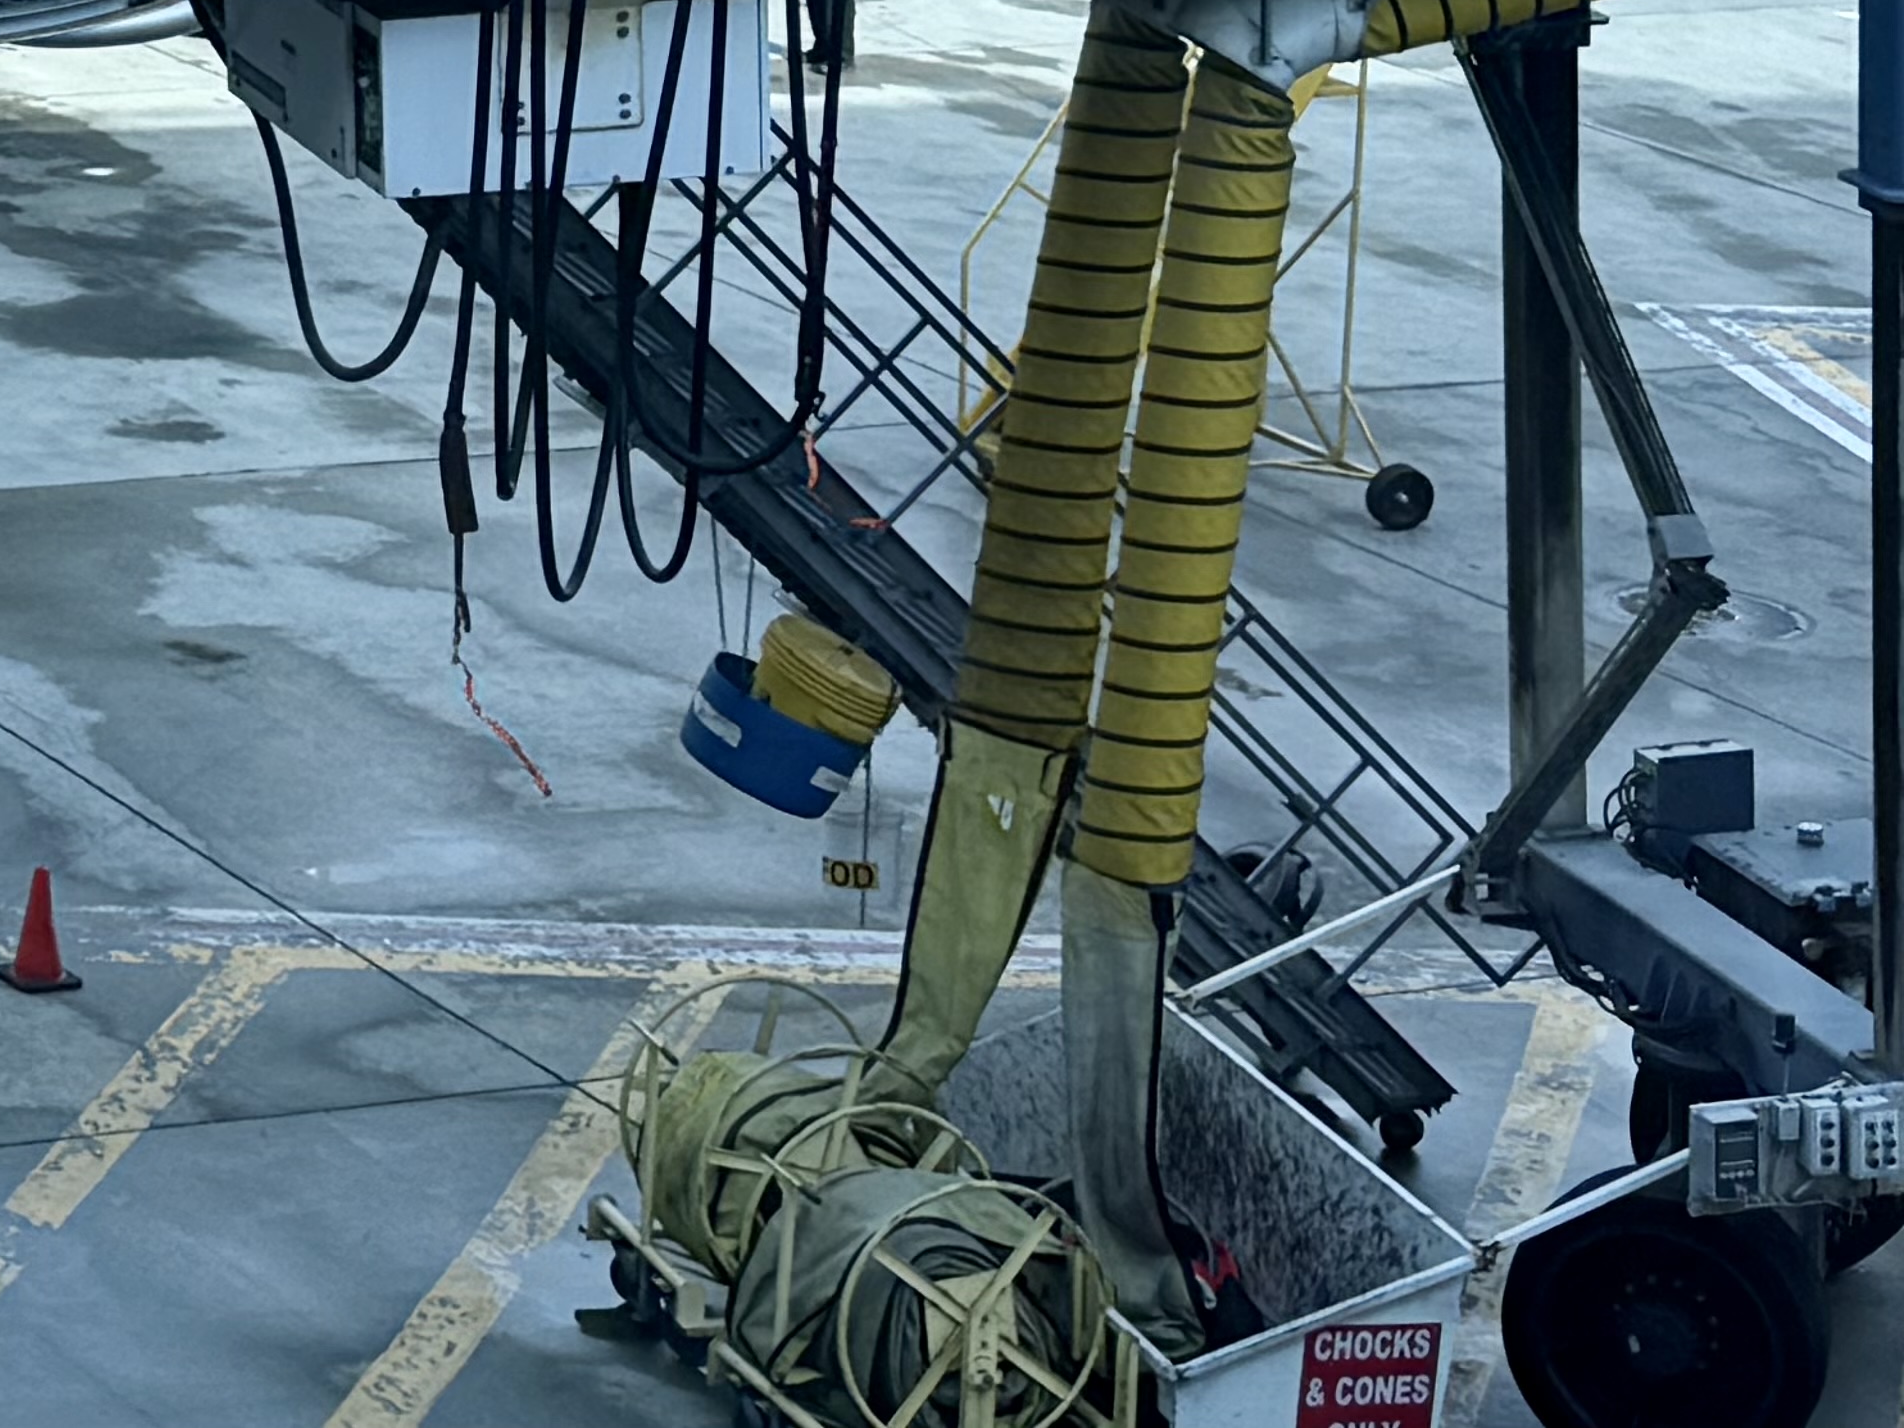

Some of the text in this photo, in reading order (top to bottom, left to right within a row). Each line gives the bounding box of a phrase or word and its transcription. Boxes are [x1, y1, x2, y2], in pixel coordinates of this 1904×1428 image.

[1314, 1329, 1431, 1361] CHOCKS
[1305, 1374, 1430, 1407] & CONES
